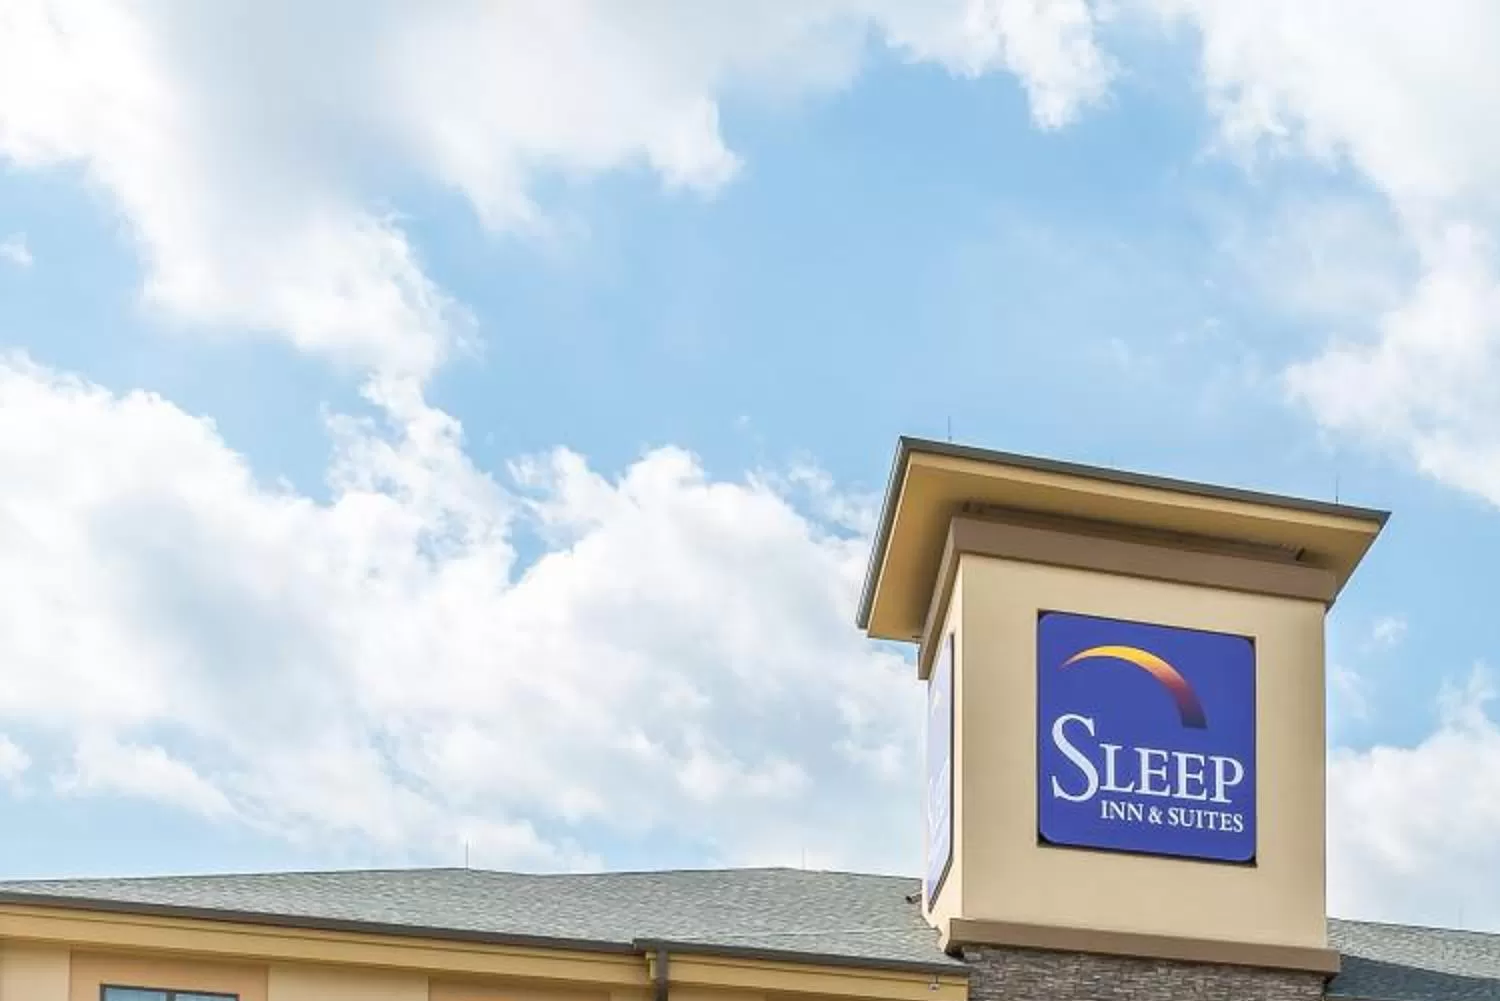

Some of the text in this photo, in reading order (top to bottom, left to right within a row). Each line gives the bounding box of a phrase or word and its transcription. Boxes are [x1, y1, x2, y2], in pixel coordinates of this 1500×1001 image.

[1052, 714, 1244, 803] SLEEP
[1101, 800, 1244, 833] INN & SUITES
